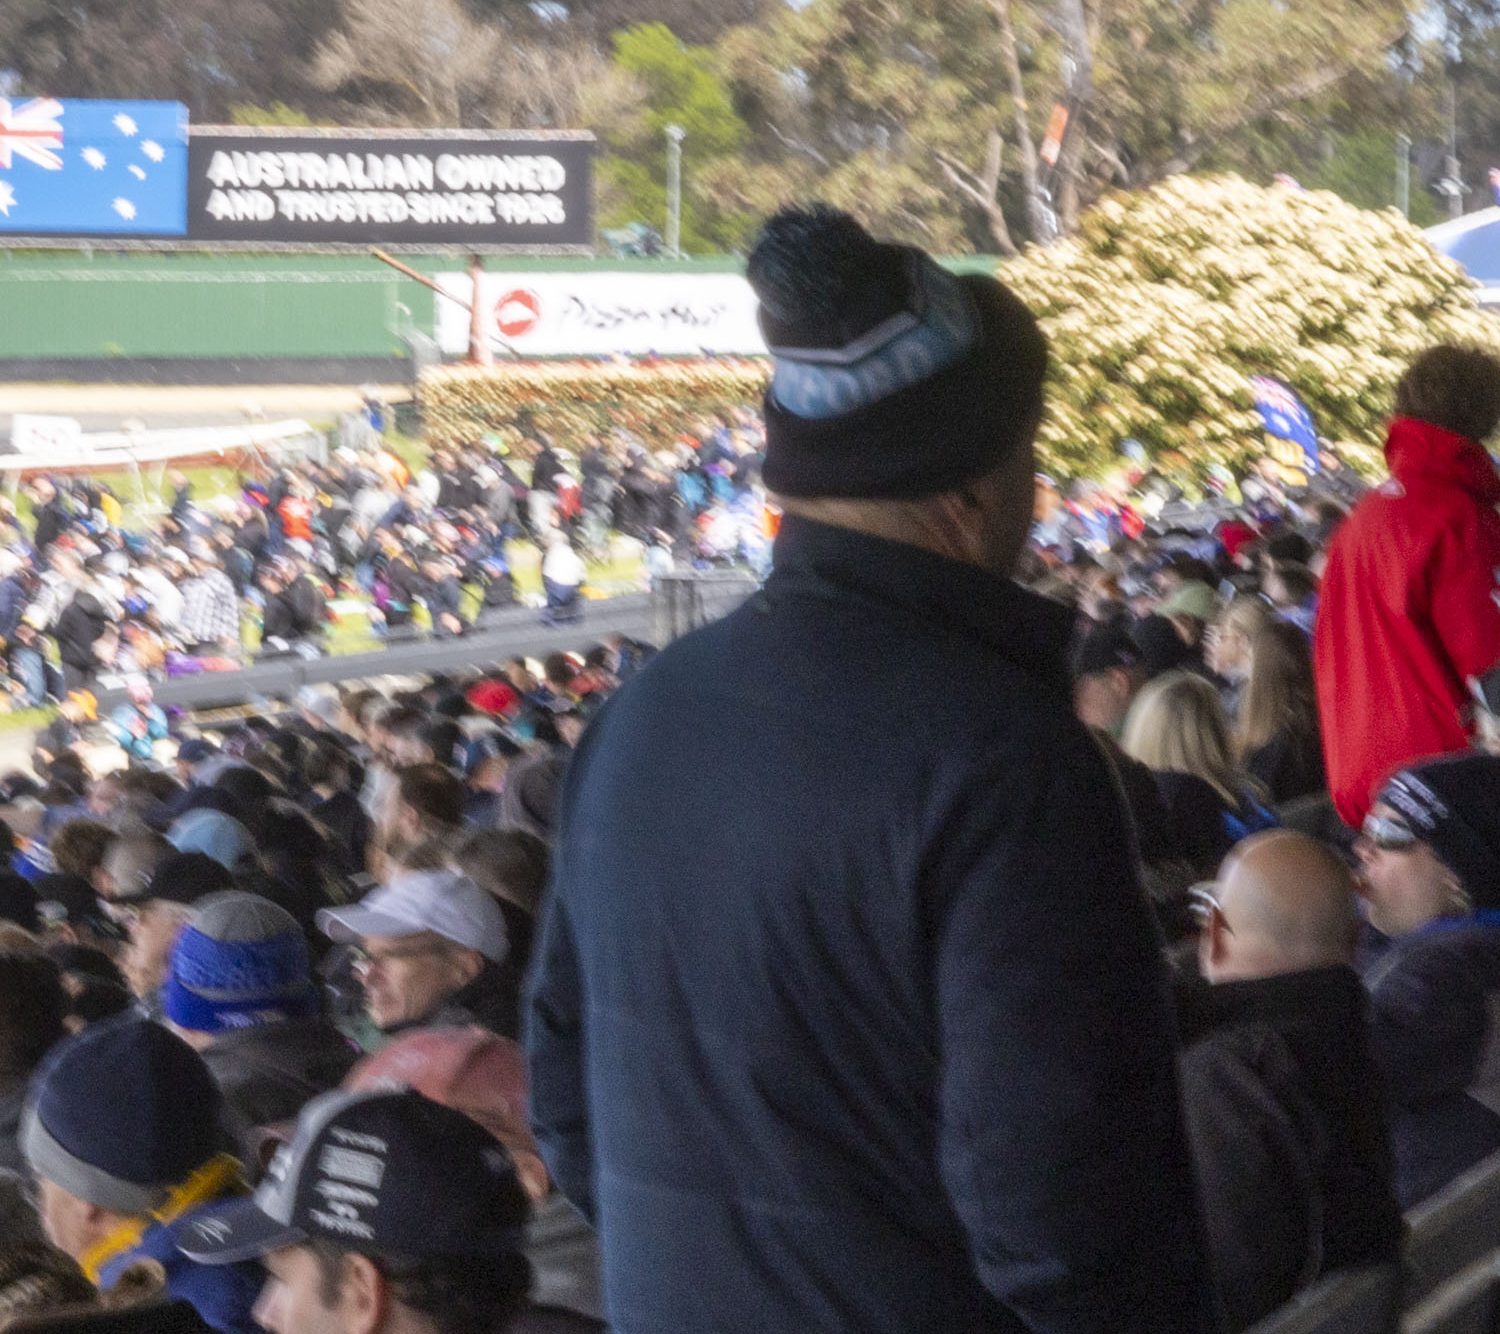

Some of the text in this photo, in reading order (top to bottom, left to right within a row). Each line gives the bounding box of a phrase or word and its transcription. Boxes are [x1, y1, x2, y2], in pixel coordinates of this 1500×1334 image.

[206, 150, 566, 192] AUSTRALIAN OWNED
[206, 188, 276, 222] AND
[274, 189, 409, 224] TRUSTED
[405, 192, 496, 225] SINCE
